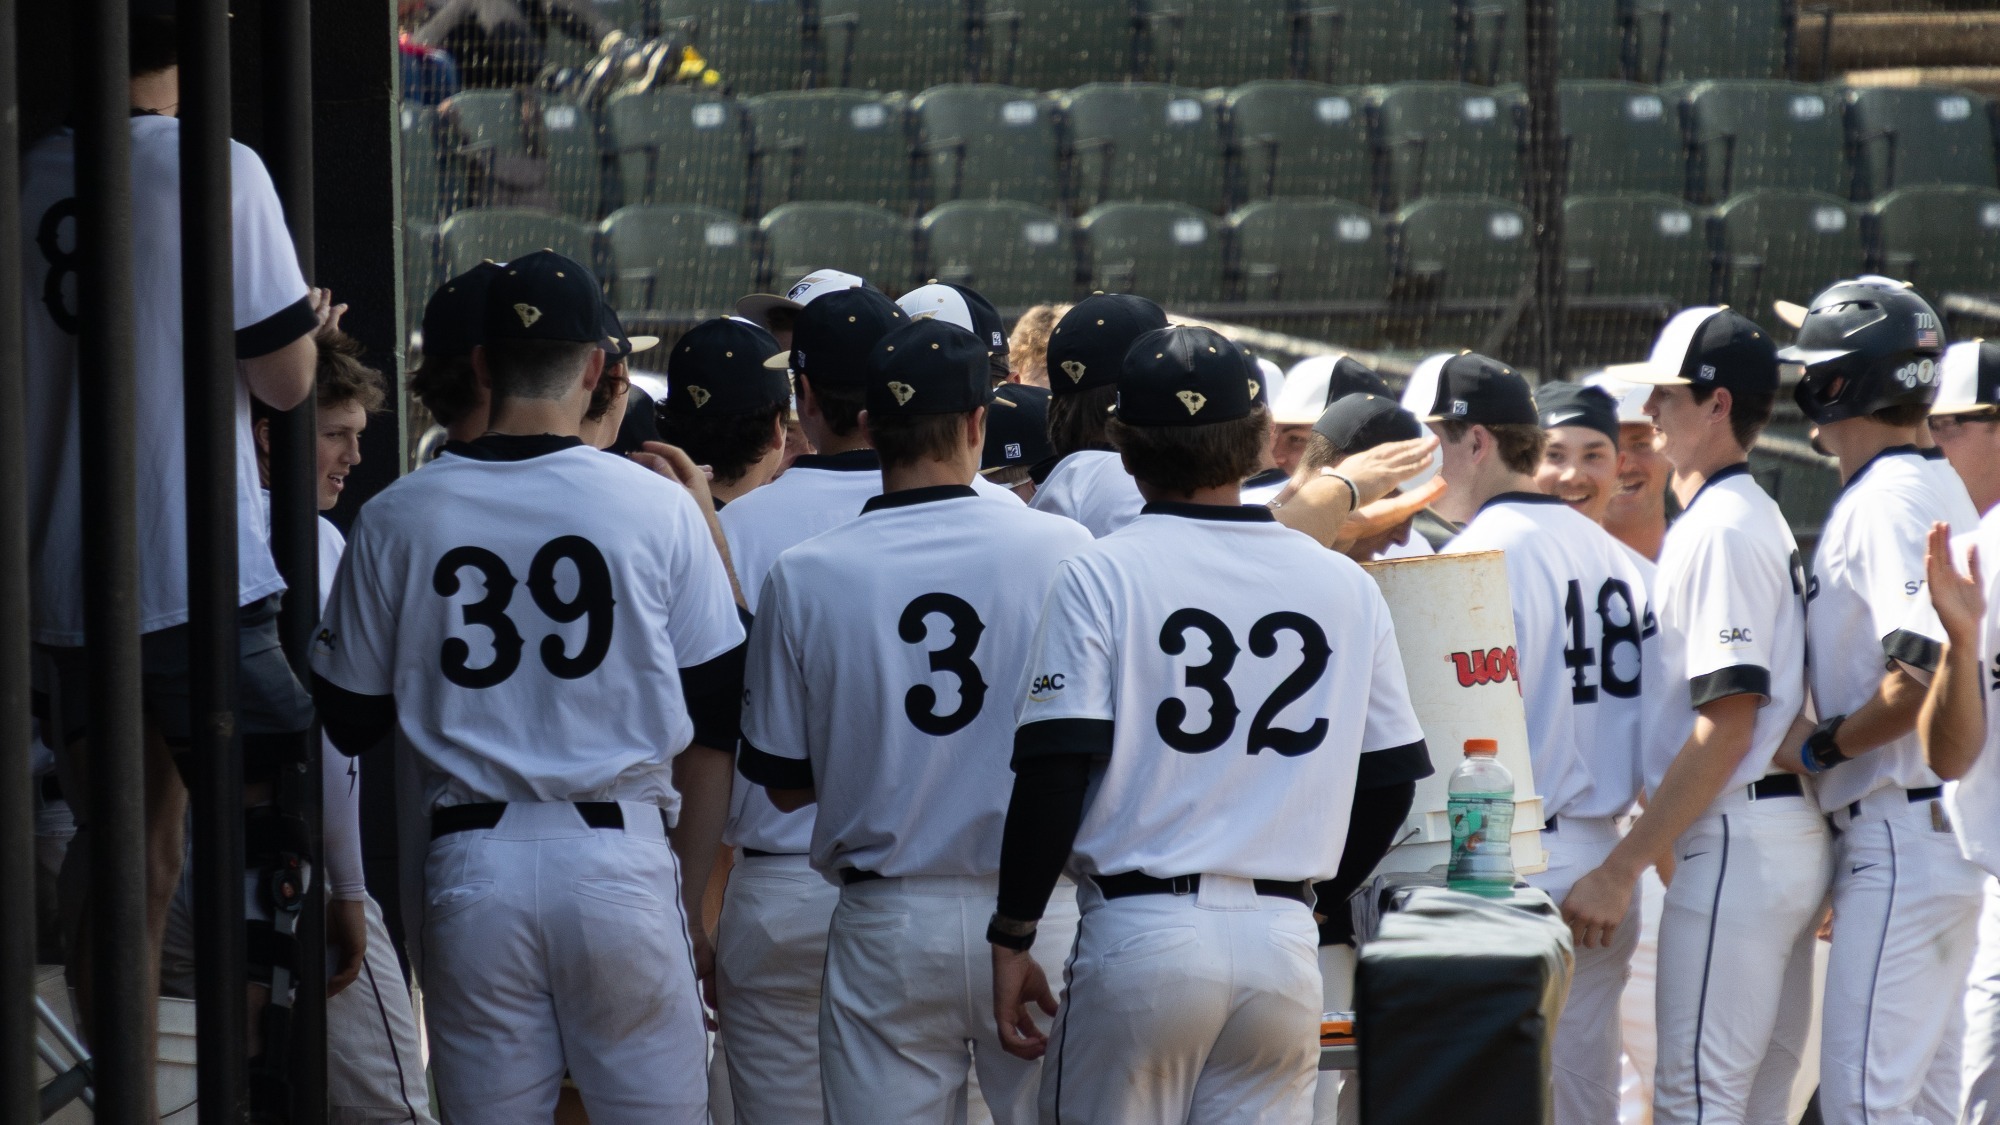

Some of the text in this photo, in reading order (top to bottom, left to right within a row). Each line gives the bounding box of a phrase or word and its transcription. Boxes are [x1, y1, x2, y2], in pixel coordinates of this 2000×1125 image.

[315, 628, 337, 651] AC
[425, 535, 616, 700] 39
[899, 593, 988, 736] 3
[1564, 578, 1642, 704] 48
[1719, 627, 1753, 644] SAC
[1031, 673, 1066, 695] SAC
[1156, 608, 1332, 756] 32
